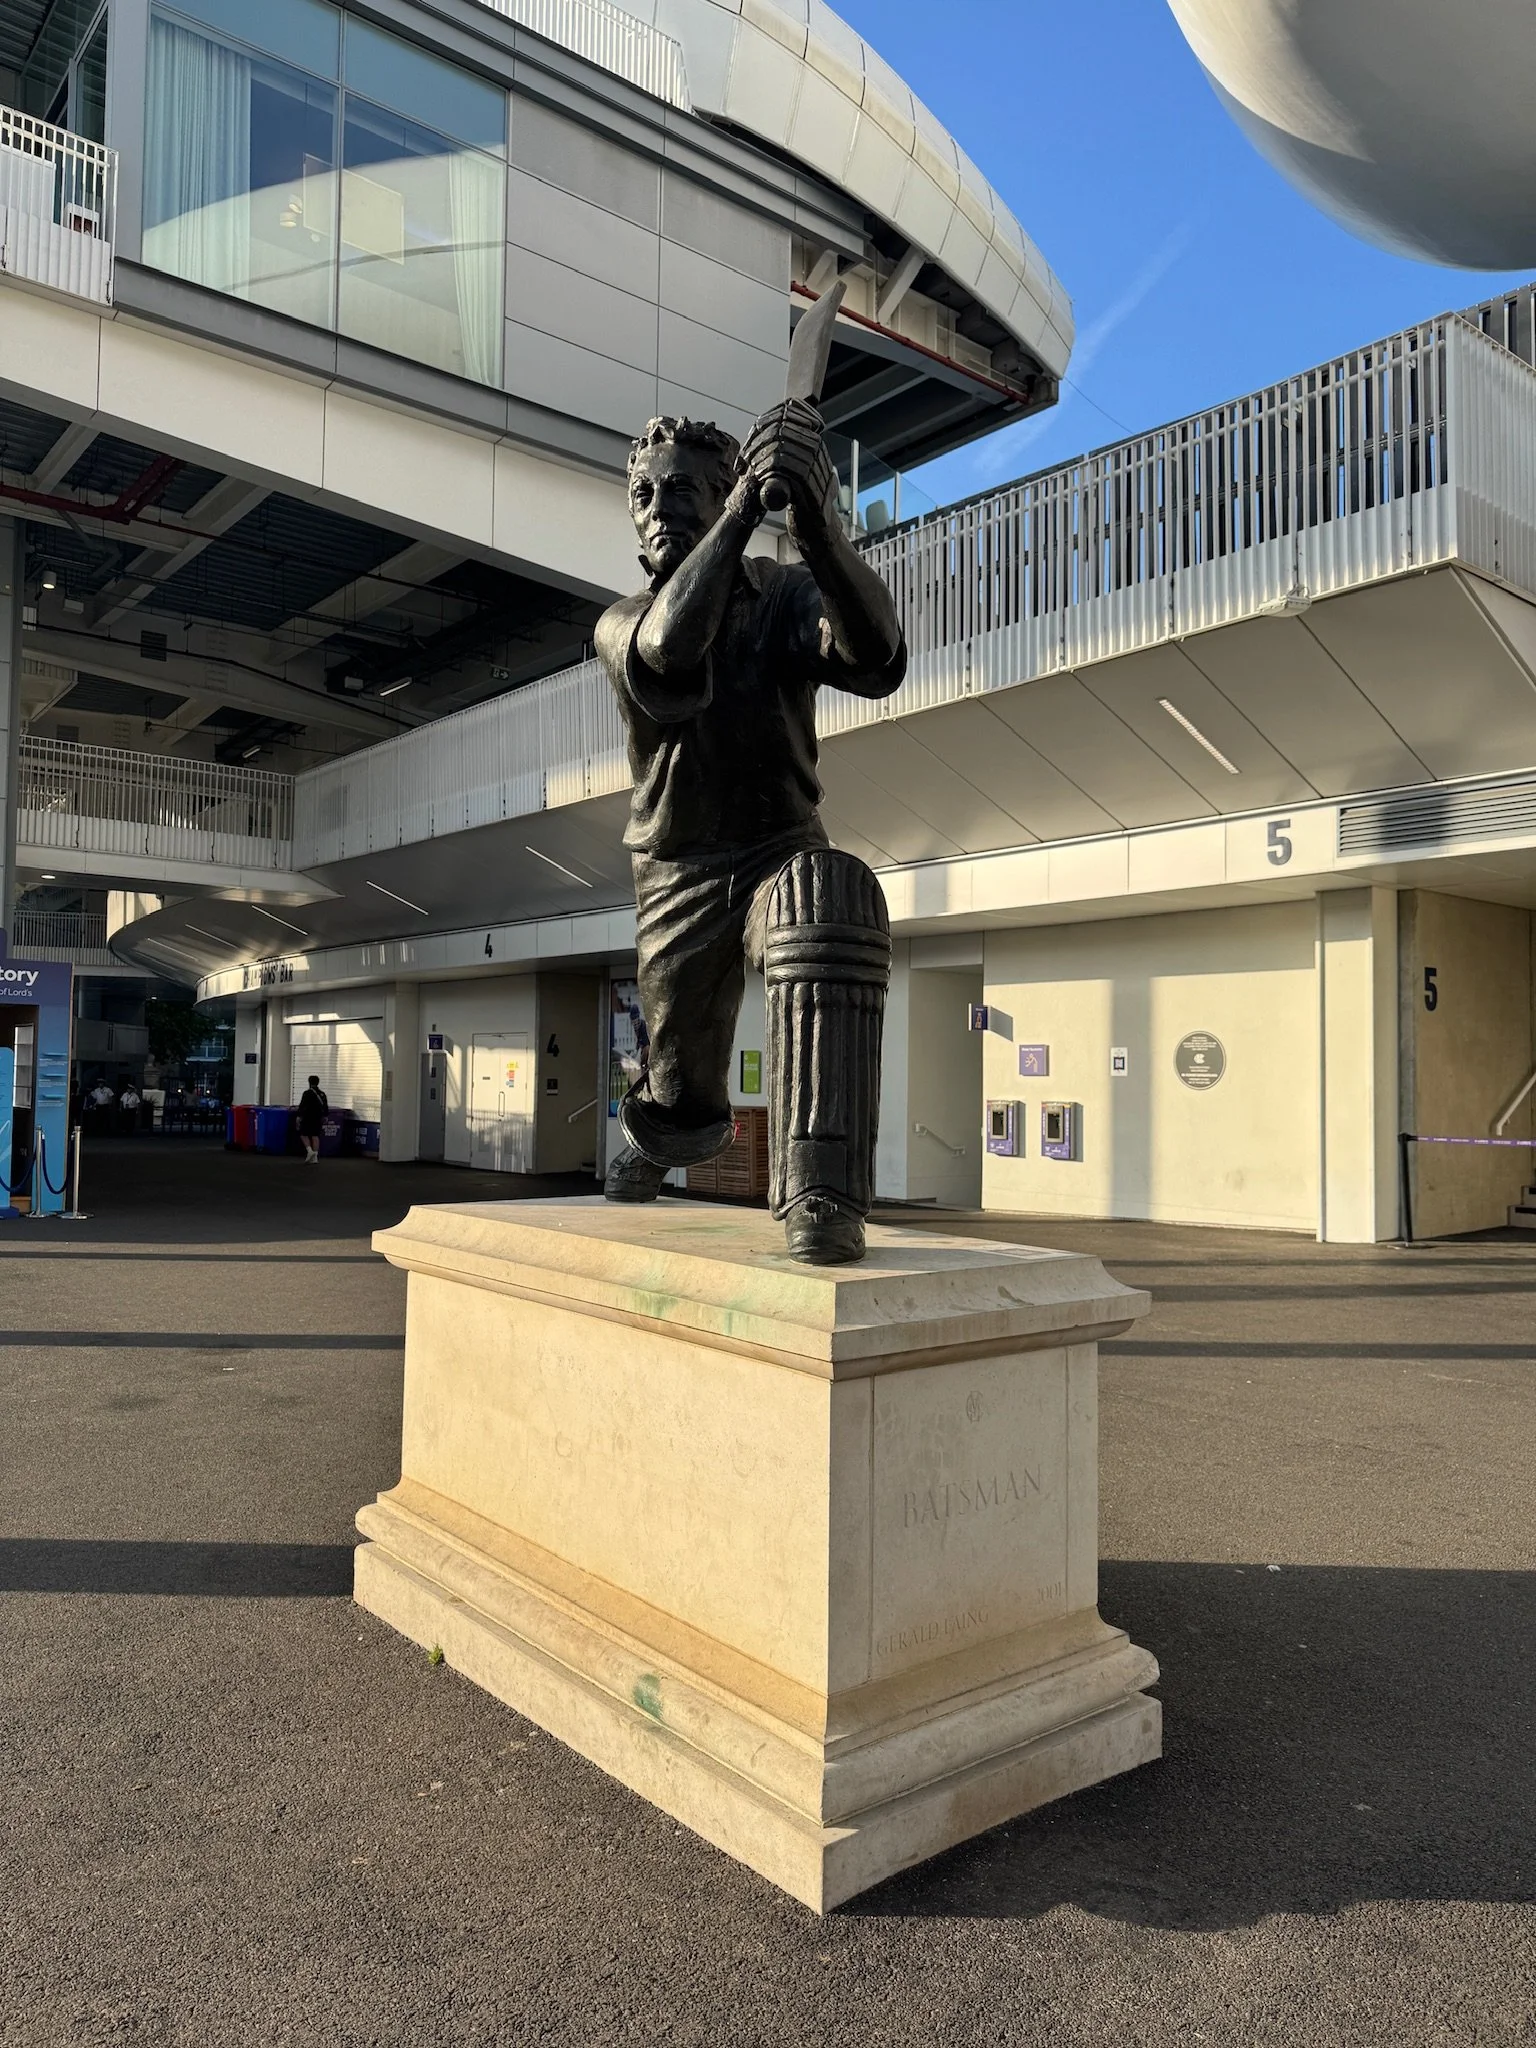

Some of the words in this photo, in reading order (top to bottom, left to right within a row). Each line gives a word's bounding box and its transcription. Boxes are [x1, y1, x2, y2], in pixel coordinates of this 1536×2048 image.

[1267, 818, 1292, 865] 5
[485, 933, 493, 958] 4
[280, 963, 293, 983] BAR
[8, 988, 33, 997] Lord's
[1424, 966, 1438, 1012] 5
[547, 1033, 560, 1057] 4
[903, 1464, 1042, 1528] BATSMAN
[876, 1620, 940, 1656] GERALD
